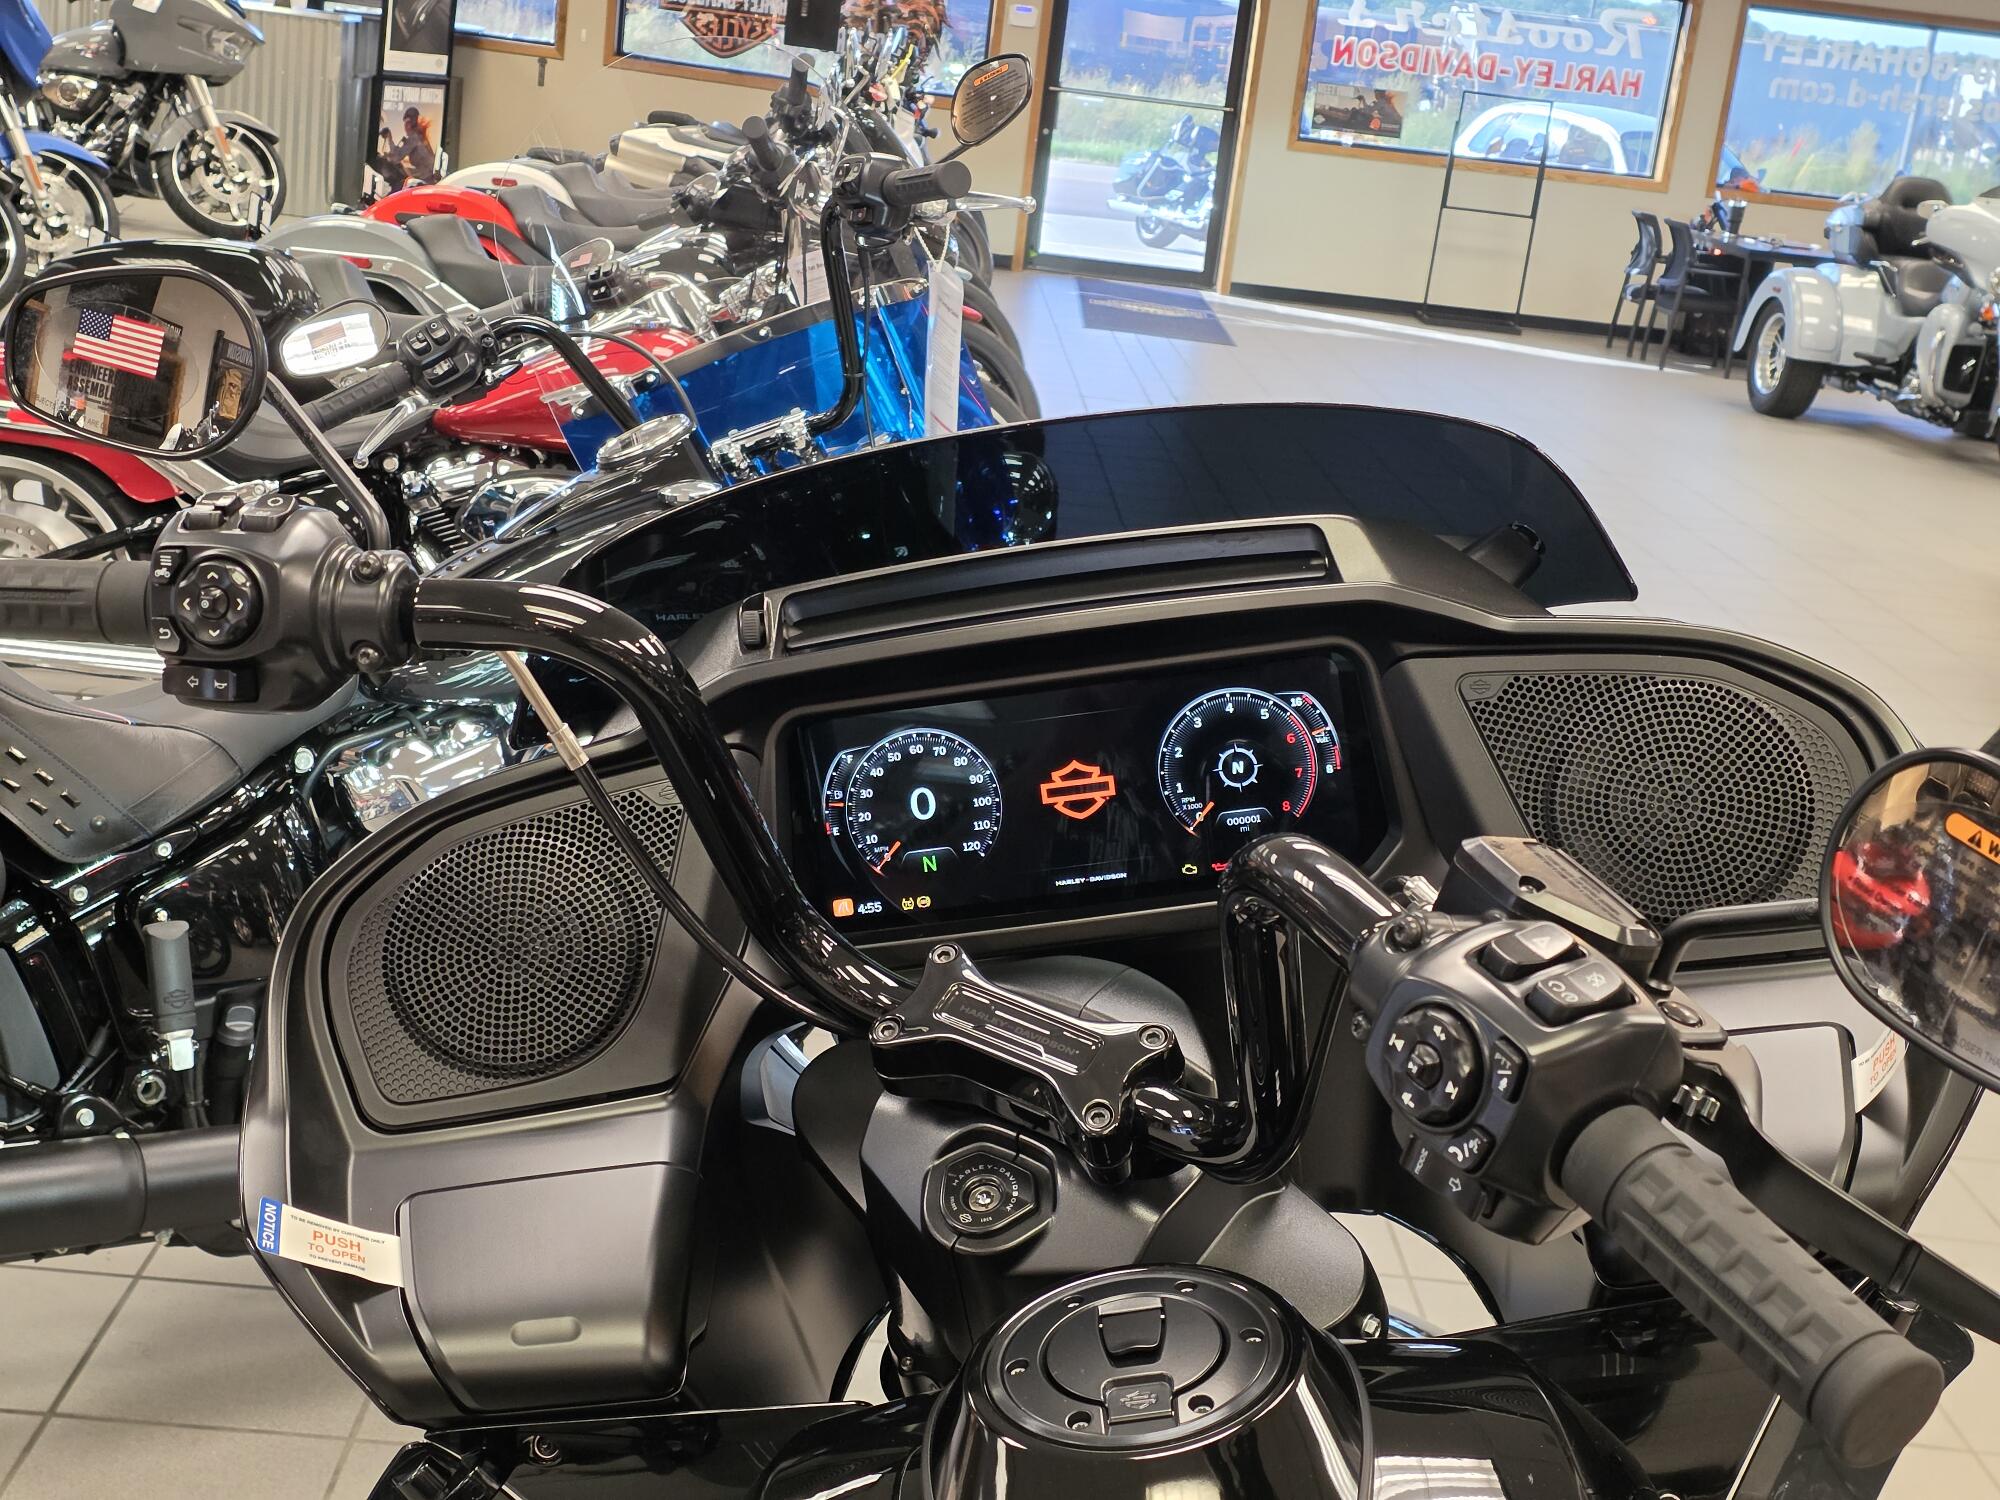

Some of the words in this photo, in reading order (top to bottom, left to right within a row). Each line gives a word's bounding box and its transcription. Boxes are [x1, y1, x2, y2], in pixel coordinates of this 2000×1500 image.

[1225, 702, 1235, 713] 4
[1289, 696, 1303, 707] 16
[1260, 708, 1270, 719] 5
[1193, 717, 1203, 728] 3
[1286, 733, 1296, 744] 6
[909, 743, 924, 755] 60
[932, 745, 947, 757] 70
[1174, 746, 1184, 758] 2
[846, 754, 854, 764] F
[887, 751, 902, 763] 50
[953, 756, 968, 767] 80
[869, 767, 884, 778] 40
[1231, 760, 1245, 774] N
[1294, 767, 1304, 778] 7
[1325, 763, 1334, 774] 8
[968, 774, 984, 785] 90
[859, 788, 874, 799] 30
[1175, 782, 1184, 794] 1
[910, 786, 937, 821] 0
[972, 796, 993, 807] 100
[1181, 796, 1196, 804] RPM
[1282, 801, 1291, 812] 8
[857, 811, 872, 823] 20
[1226, 814, 1262, 826] 000001
[832, 826, 841, 837] E
[973, 820, 991, 832] 110
[1239, 824, 1250, 833] mi
[865, 834, 879, 845] 10
[962, 840, 982, 852] 120
[922, 854, 938, 873] N
[1055, 872, 1128, 887] HARLEY-DAVIDSON
[857, 901, 883, 915] 4:55
[959, 1003, 1079, 1055] HARLEY-DAVIDSON
[1414, 1147, 1429, 1175] MODE
[952, 1163, 1020, 1212] HARLEY-DAVIDSON
[262, 1202, 277, 1250] NOTICE
[312, 1230, 361, 1252] PUSH
[307, 1242, 325, 1254] TO
[331, 1248, 366, 1264] OPEN
